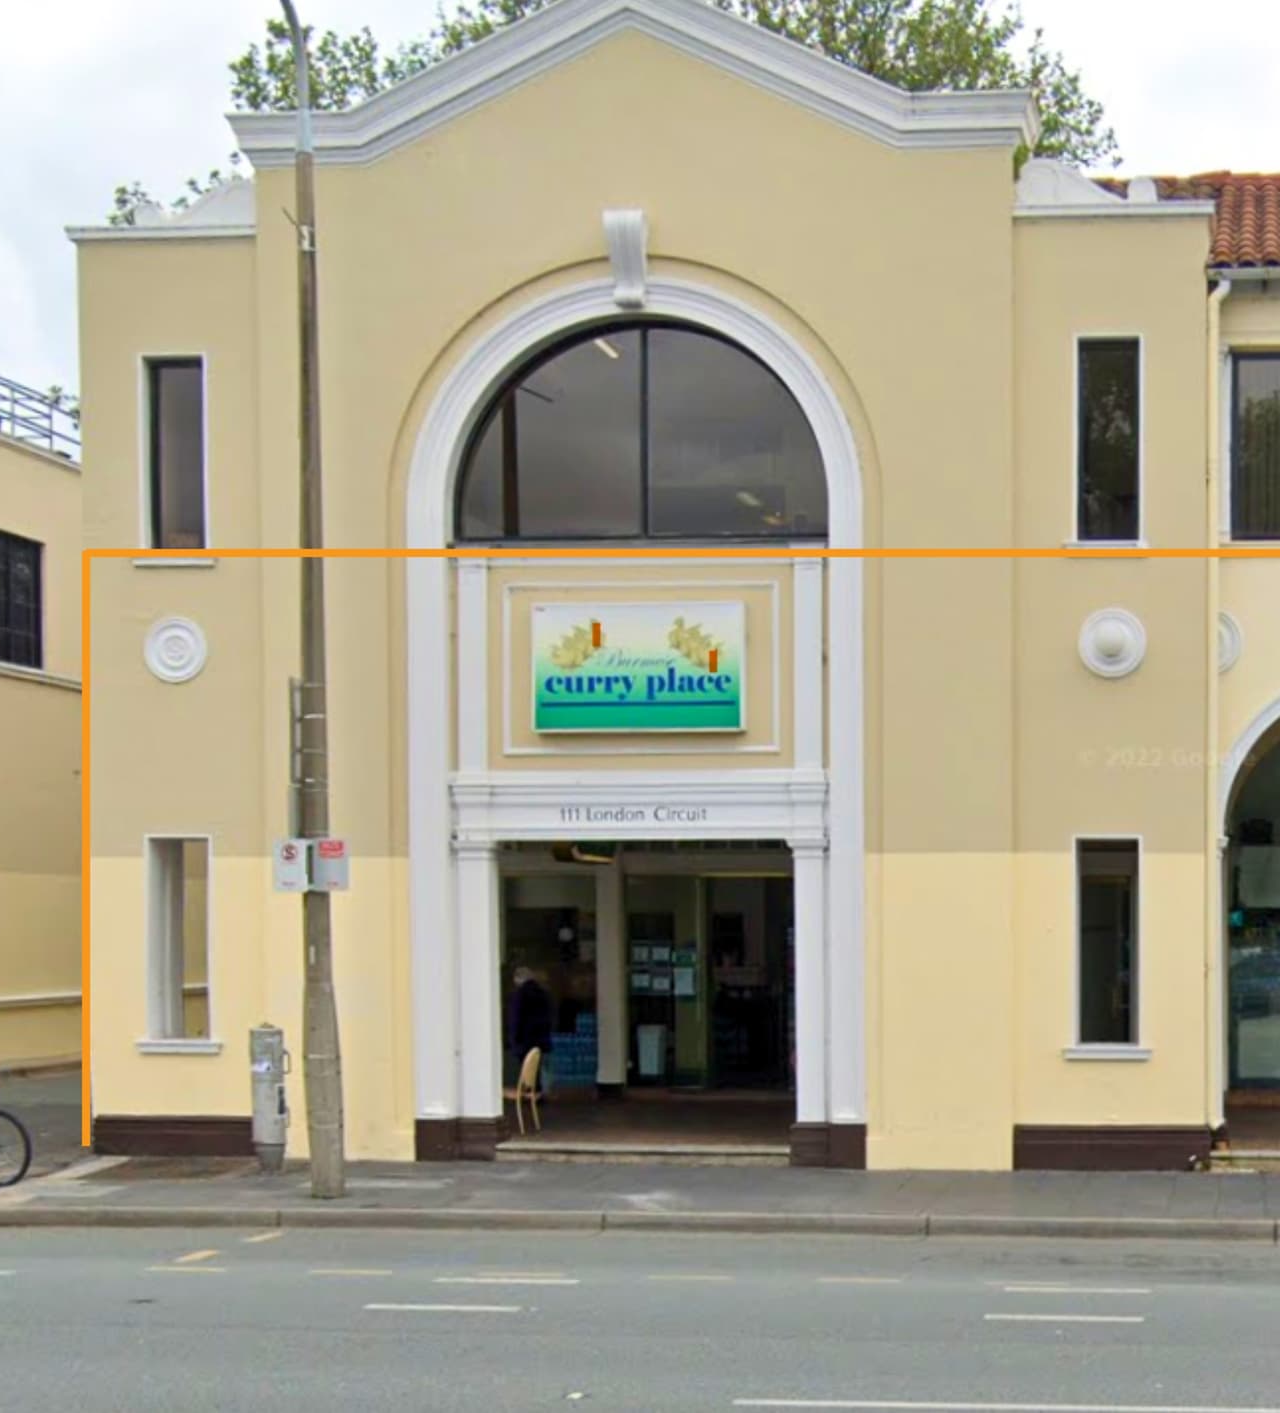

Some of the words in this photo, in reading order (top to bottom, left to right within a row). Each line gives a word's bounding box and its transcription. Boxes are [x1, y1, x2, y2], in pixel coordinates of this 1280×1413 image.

[544, 674, 634, 700] curry
[647, 666, 732, 700] place
[560, 807, 580, 822] 111
[586, 806, 645, 822] London
[654, 806, 708, 822] Circuit
